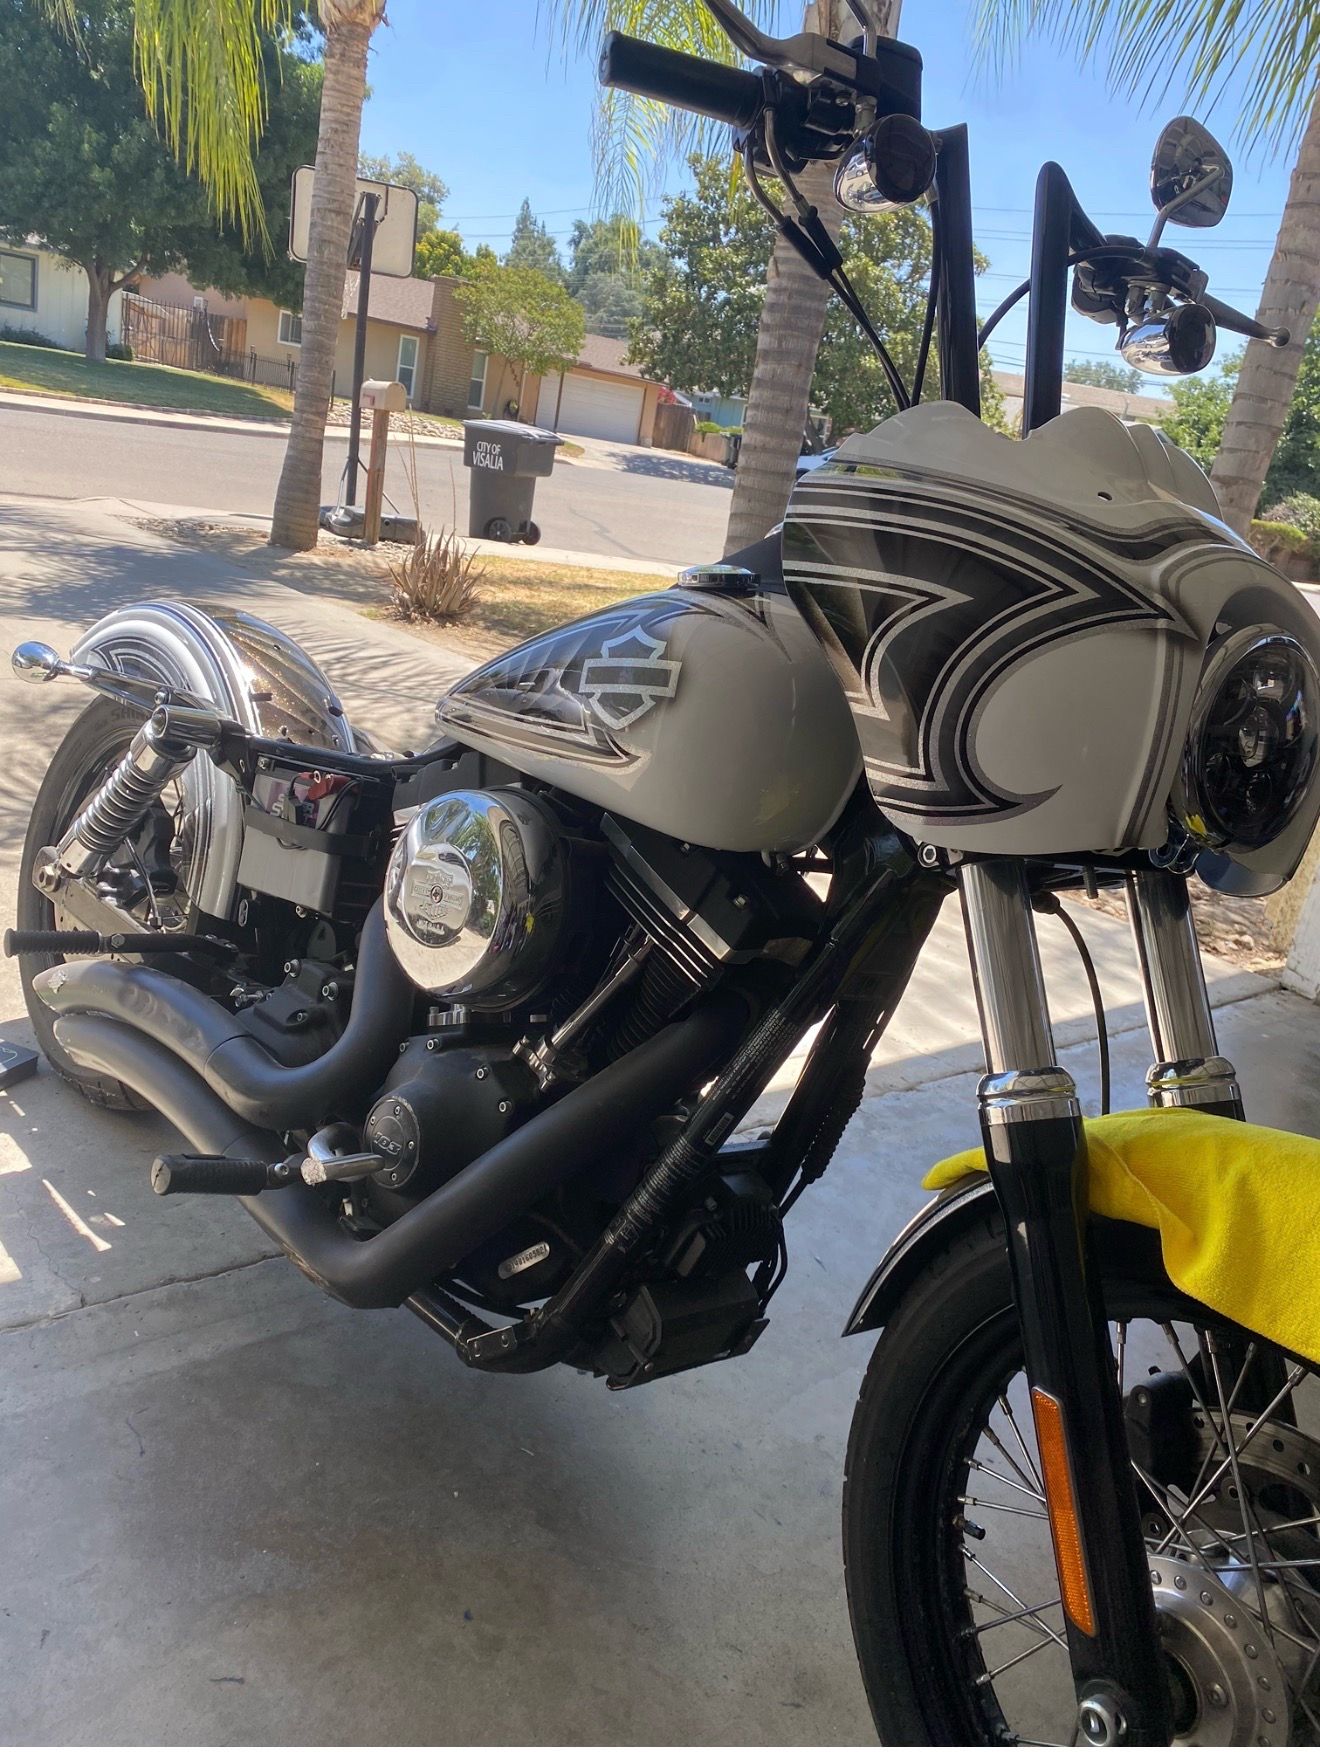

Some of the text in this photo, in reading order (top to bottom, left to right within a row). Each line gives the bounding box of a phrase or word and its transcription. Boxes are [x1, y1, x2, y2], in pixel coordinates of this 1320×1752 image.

[477, 441, 501, 455] CITY OF
[472, 451, 503, 470] VISALIA
[373, 1131, 402, 1155] 103
